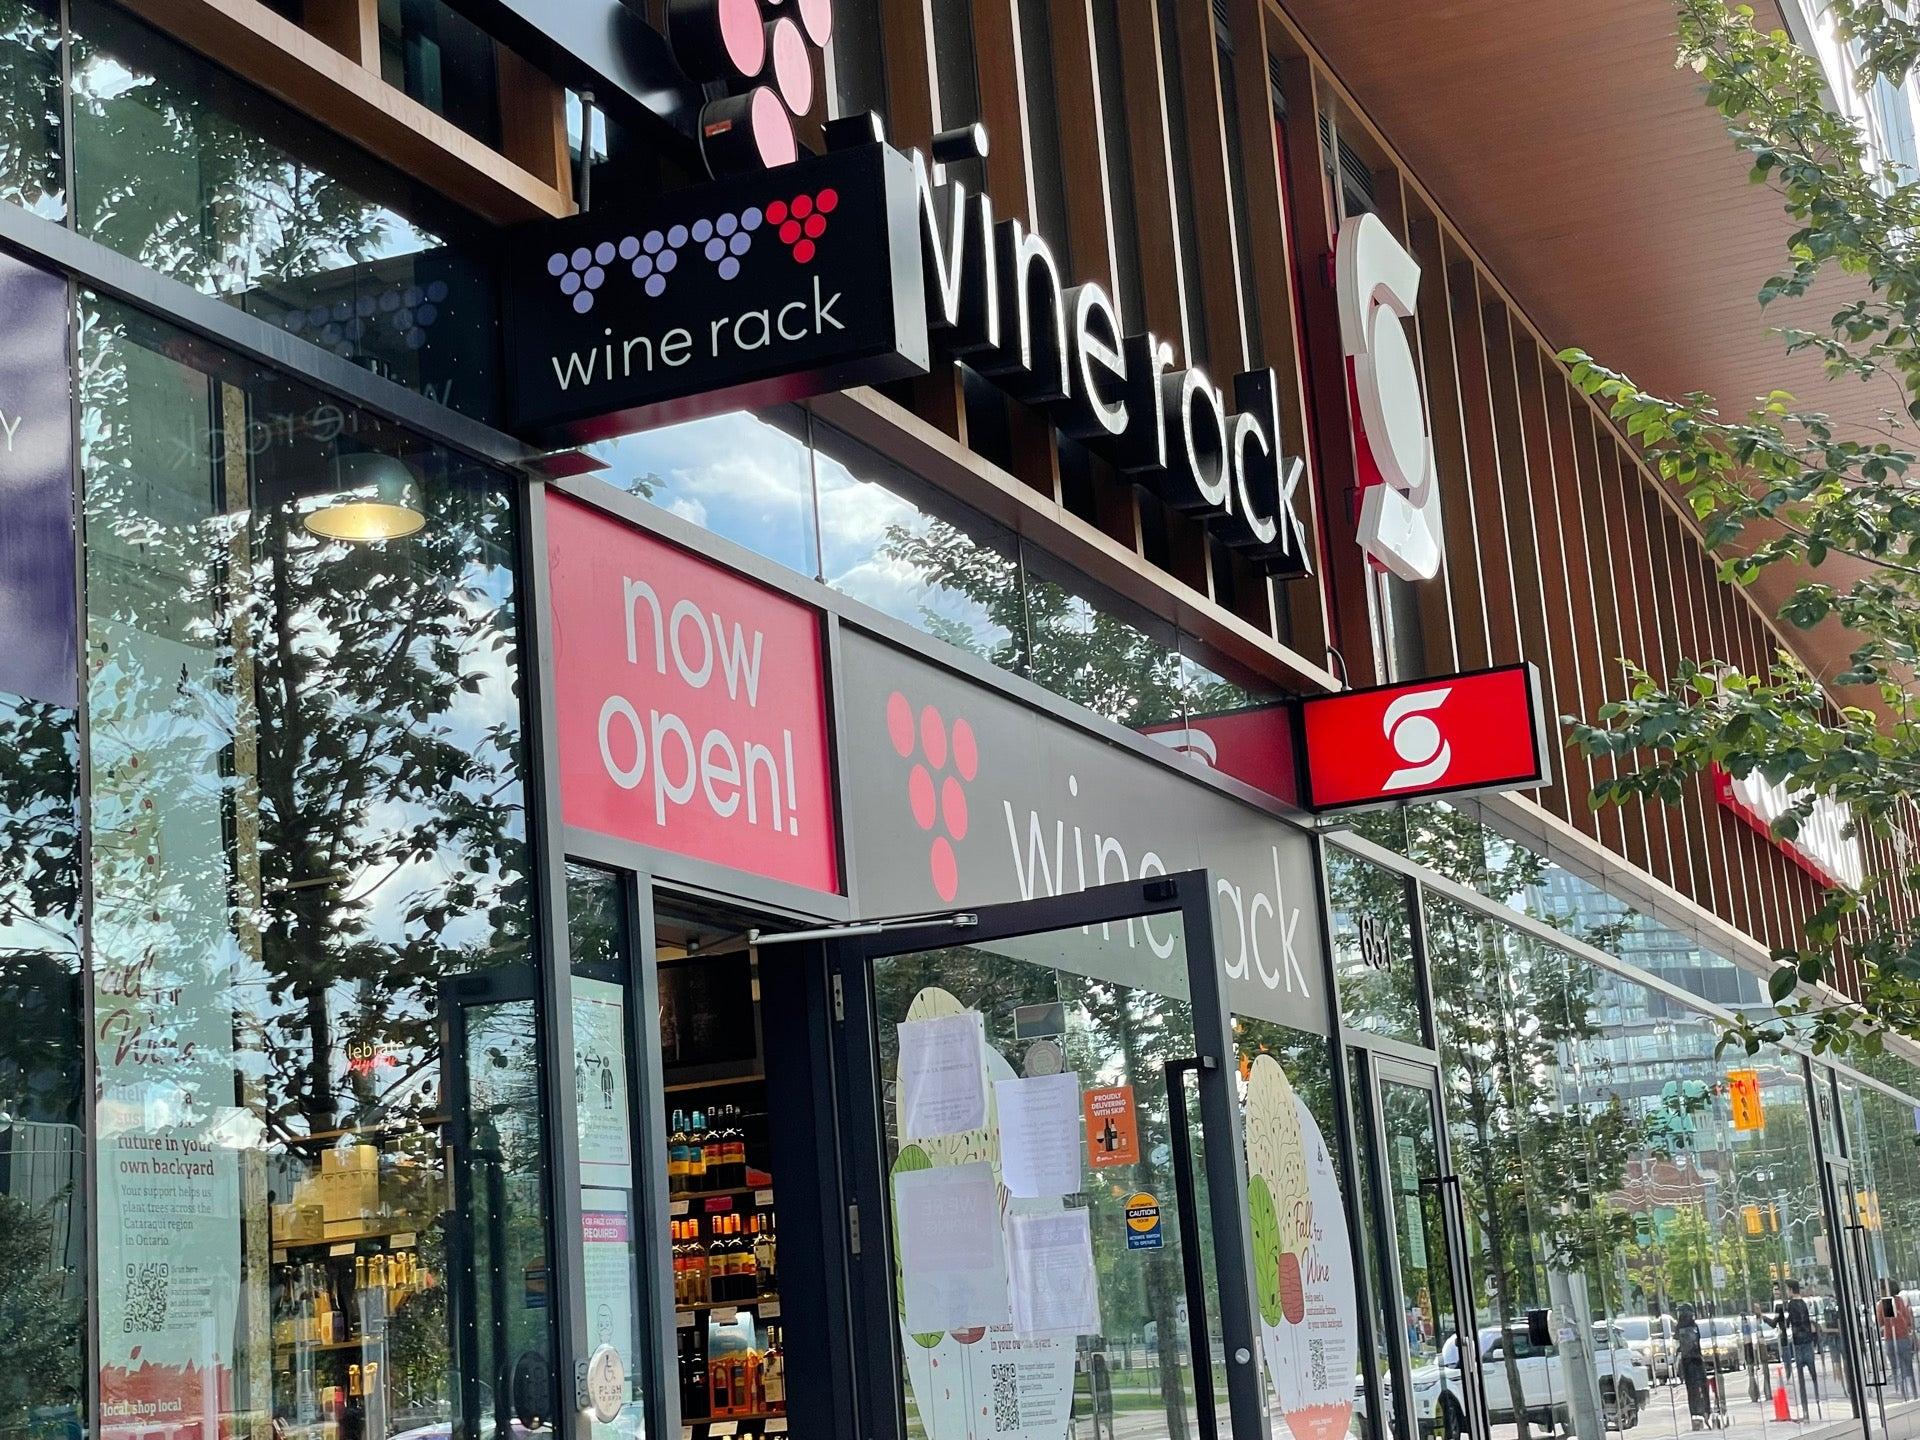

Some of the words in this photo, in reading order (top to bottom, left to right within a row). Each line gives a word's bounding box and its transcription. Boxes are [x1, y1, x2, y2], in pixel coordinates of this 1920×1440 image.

[551, 326, 693, 390] wine
[710, 275, 846, 357] rack
[1148, 331, 1314, 576] rack
[623, 575, 764, 707] now
[598, 694, 799, 837] open!
[1189, 846, 1311, 998] ack
[1359, 911, 1393, 973] 651
[347, 1039, 405, 1060] lebrate
[1091, 1099, 1127, 1110] DELIVERING
[1094, 1092, 1122, 1102] PROUDLY
[1093, 1108, 1111, 1117] WITH
[165, 1134, 179, 1151] in
[120, 1160, 149, 1174] own
[152, 1157, 214, 1179] backyard
[121, 1184, 141, 1197] Your
[143, 1186, 177, 1199] support
[179, 1184, 200, 1200] helps
[202, 1189, 212, 1198] us
[123, 1201, 146, 1215] plant
[147, 1204, 169, 1214] trees
[170, 1204, 196, 1214] across
[197, 1203, 212, 1214] the
[1129, 1208, 1156, 1217] CAUTION
[124, 1217, 166, 1232] Cataraqui
[167, 1220, 194, 1232] region
[1293, 1200, 1314, 1242] Fall
[1314, 1222, 1323, 1242] for
[125, 1234, 134, 1246] in
[584, 1227, 618, 1239] REQUIRED
[1302, 1244, 1330, 1285] Wine
[133, 1400, 156, 1417] shop
[158, 1397, 182, 1413] local
